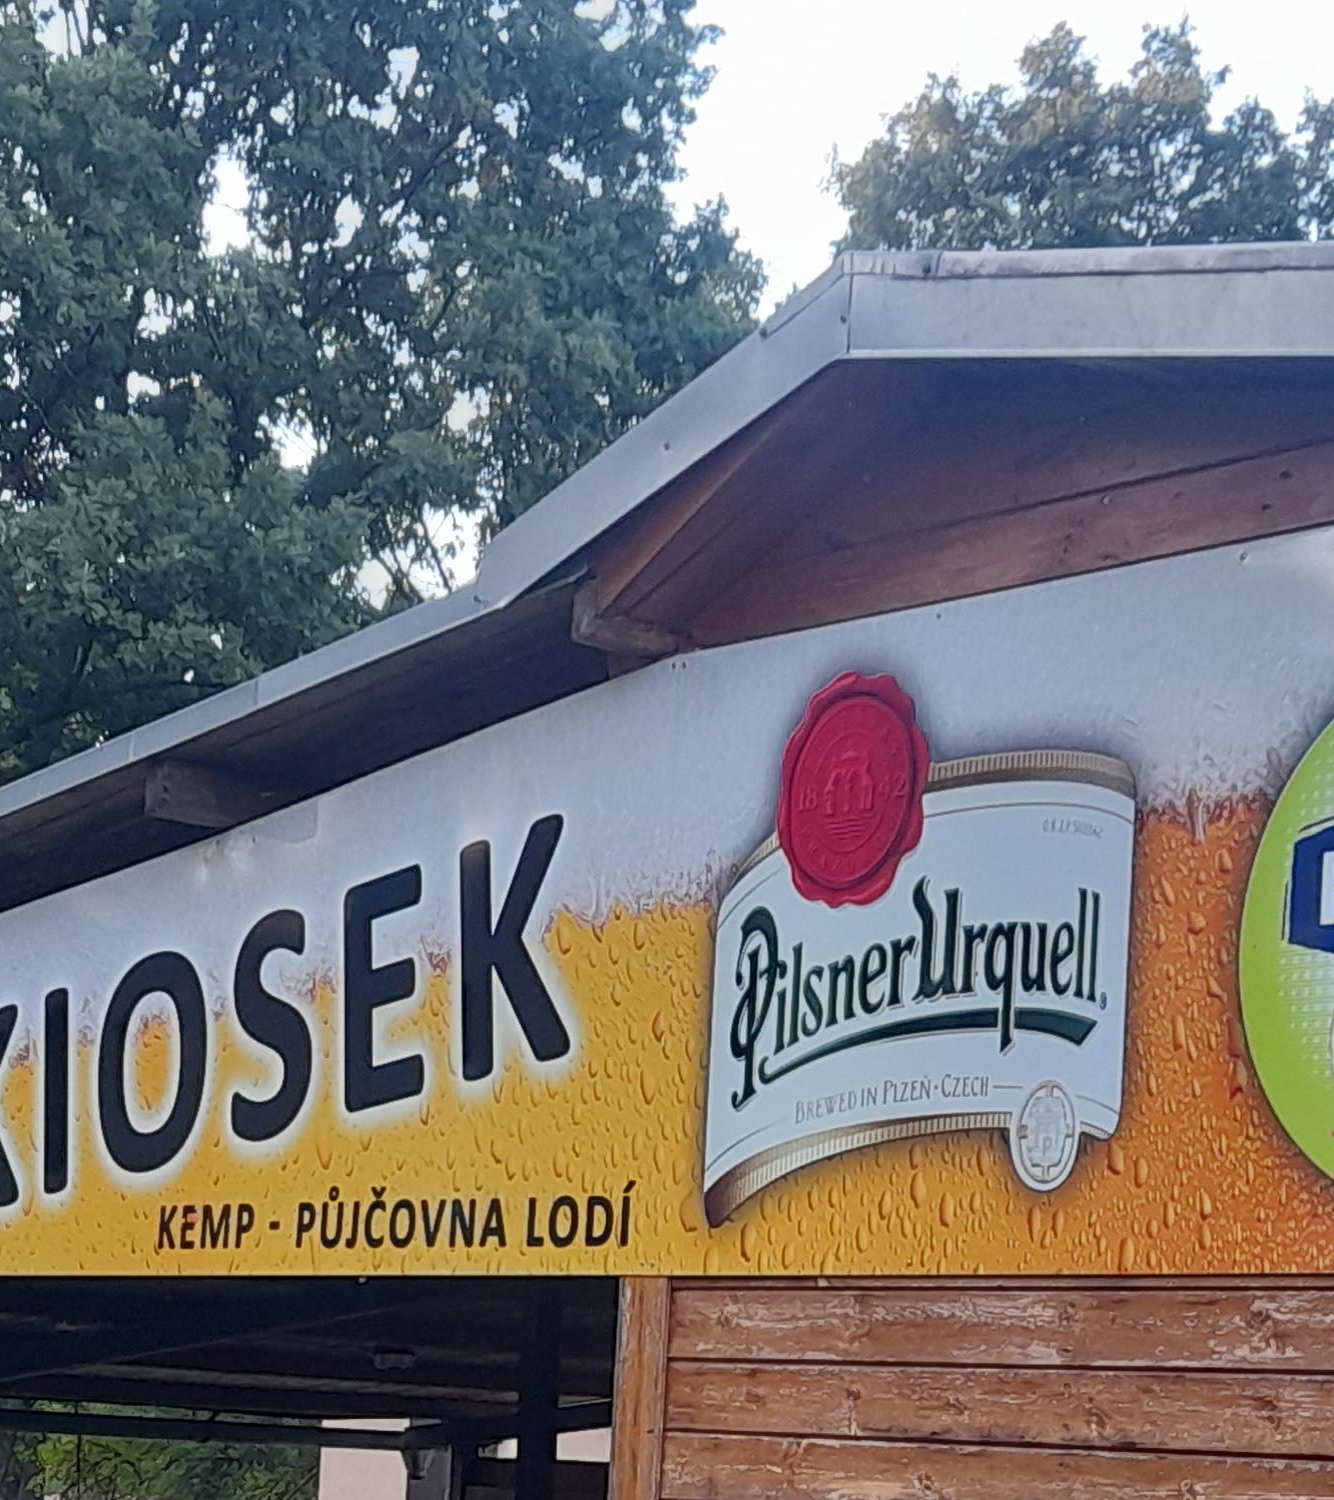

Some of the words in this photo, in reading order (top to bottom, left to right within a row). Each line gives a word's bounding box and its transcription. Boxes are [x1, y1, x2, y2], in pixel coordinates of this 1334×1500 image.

[730, 906, 917, 1110] Pilsner
[913, 875, 1103, 1054] Urquell
[795, 1091, 857, 1124] BREWED
[860, 1085, 879, 1108] IN
[882, 1075, 932, 1105] PLZEŇ
[940, 1073, 990, 1099] CZECH
[156, 1202, 257, 1251] KEMP
[294, 1185, 509, 1250] PŮJČOVNA
[525, 1180, 637, 1248] LODÍ
